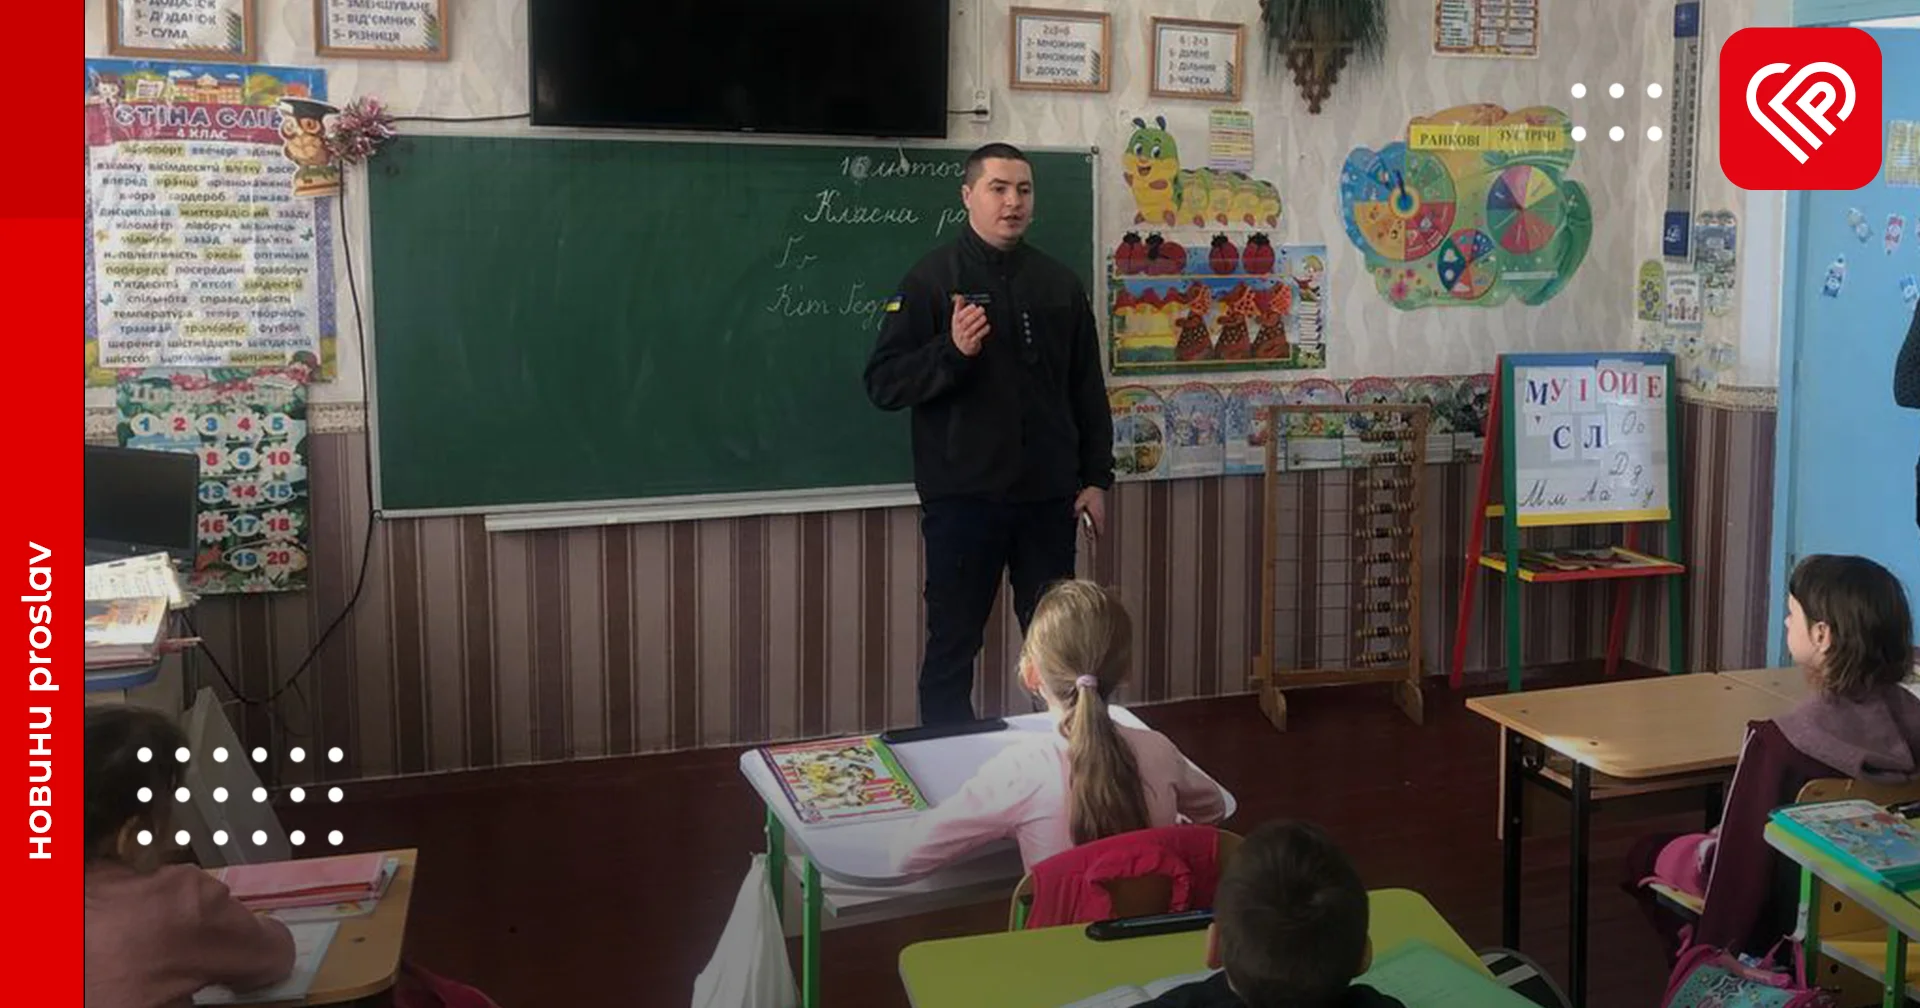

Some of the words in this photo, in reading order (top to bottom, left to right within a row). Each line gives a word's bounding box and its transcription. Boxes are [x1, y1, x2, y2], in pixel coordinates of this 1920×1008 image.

[150, 27, 189, 39] СУМА
[348, 30, 400, 42] РІЗНИЦЯ
[1036, 39, 1086, 49] МНОЖНИК
[1036, 66, 1079, 76] ДОБУТОК
[114, 104, 211, 127] СТІНА
[176, 129, 185, 138] 4
[186, 129, 229, 140] КЛАС
[1420, 132, 1480, 147] РАНКОВІ
[1498, 128, 1557, 143] ЗУСТРІЧІ
[872, 162, 966, 179] лютог
[804, 189, 919, 225] Класна
[139, 417, 149, 431] 1
[173, 417, 187, 432] 2
[206, 417, 218, 431] 3
[237, 417, 252, 431] 4
[272, 417, 284, 431] 5
[1553, 425, 1571, 449] С
[1584, 425, 1602, 449] Л
[206, 452, 218, 465] 8
[238, 451, 250, 465] 9
[268, 452, 290, 466] 10
[201, 485, 224, 498] 13
[232, 484, 256, 498] 14
[267, 484, 290, 498] 15
[201, 519, 225, 533] 16
[234, 519, 257, 533] 17
[267, 518, 290, 531] 18
[236, 552, 257, 565] 19
[267, 551, 290, 565] 20
